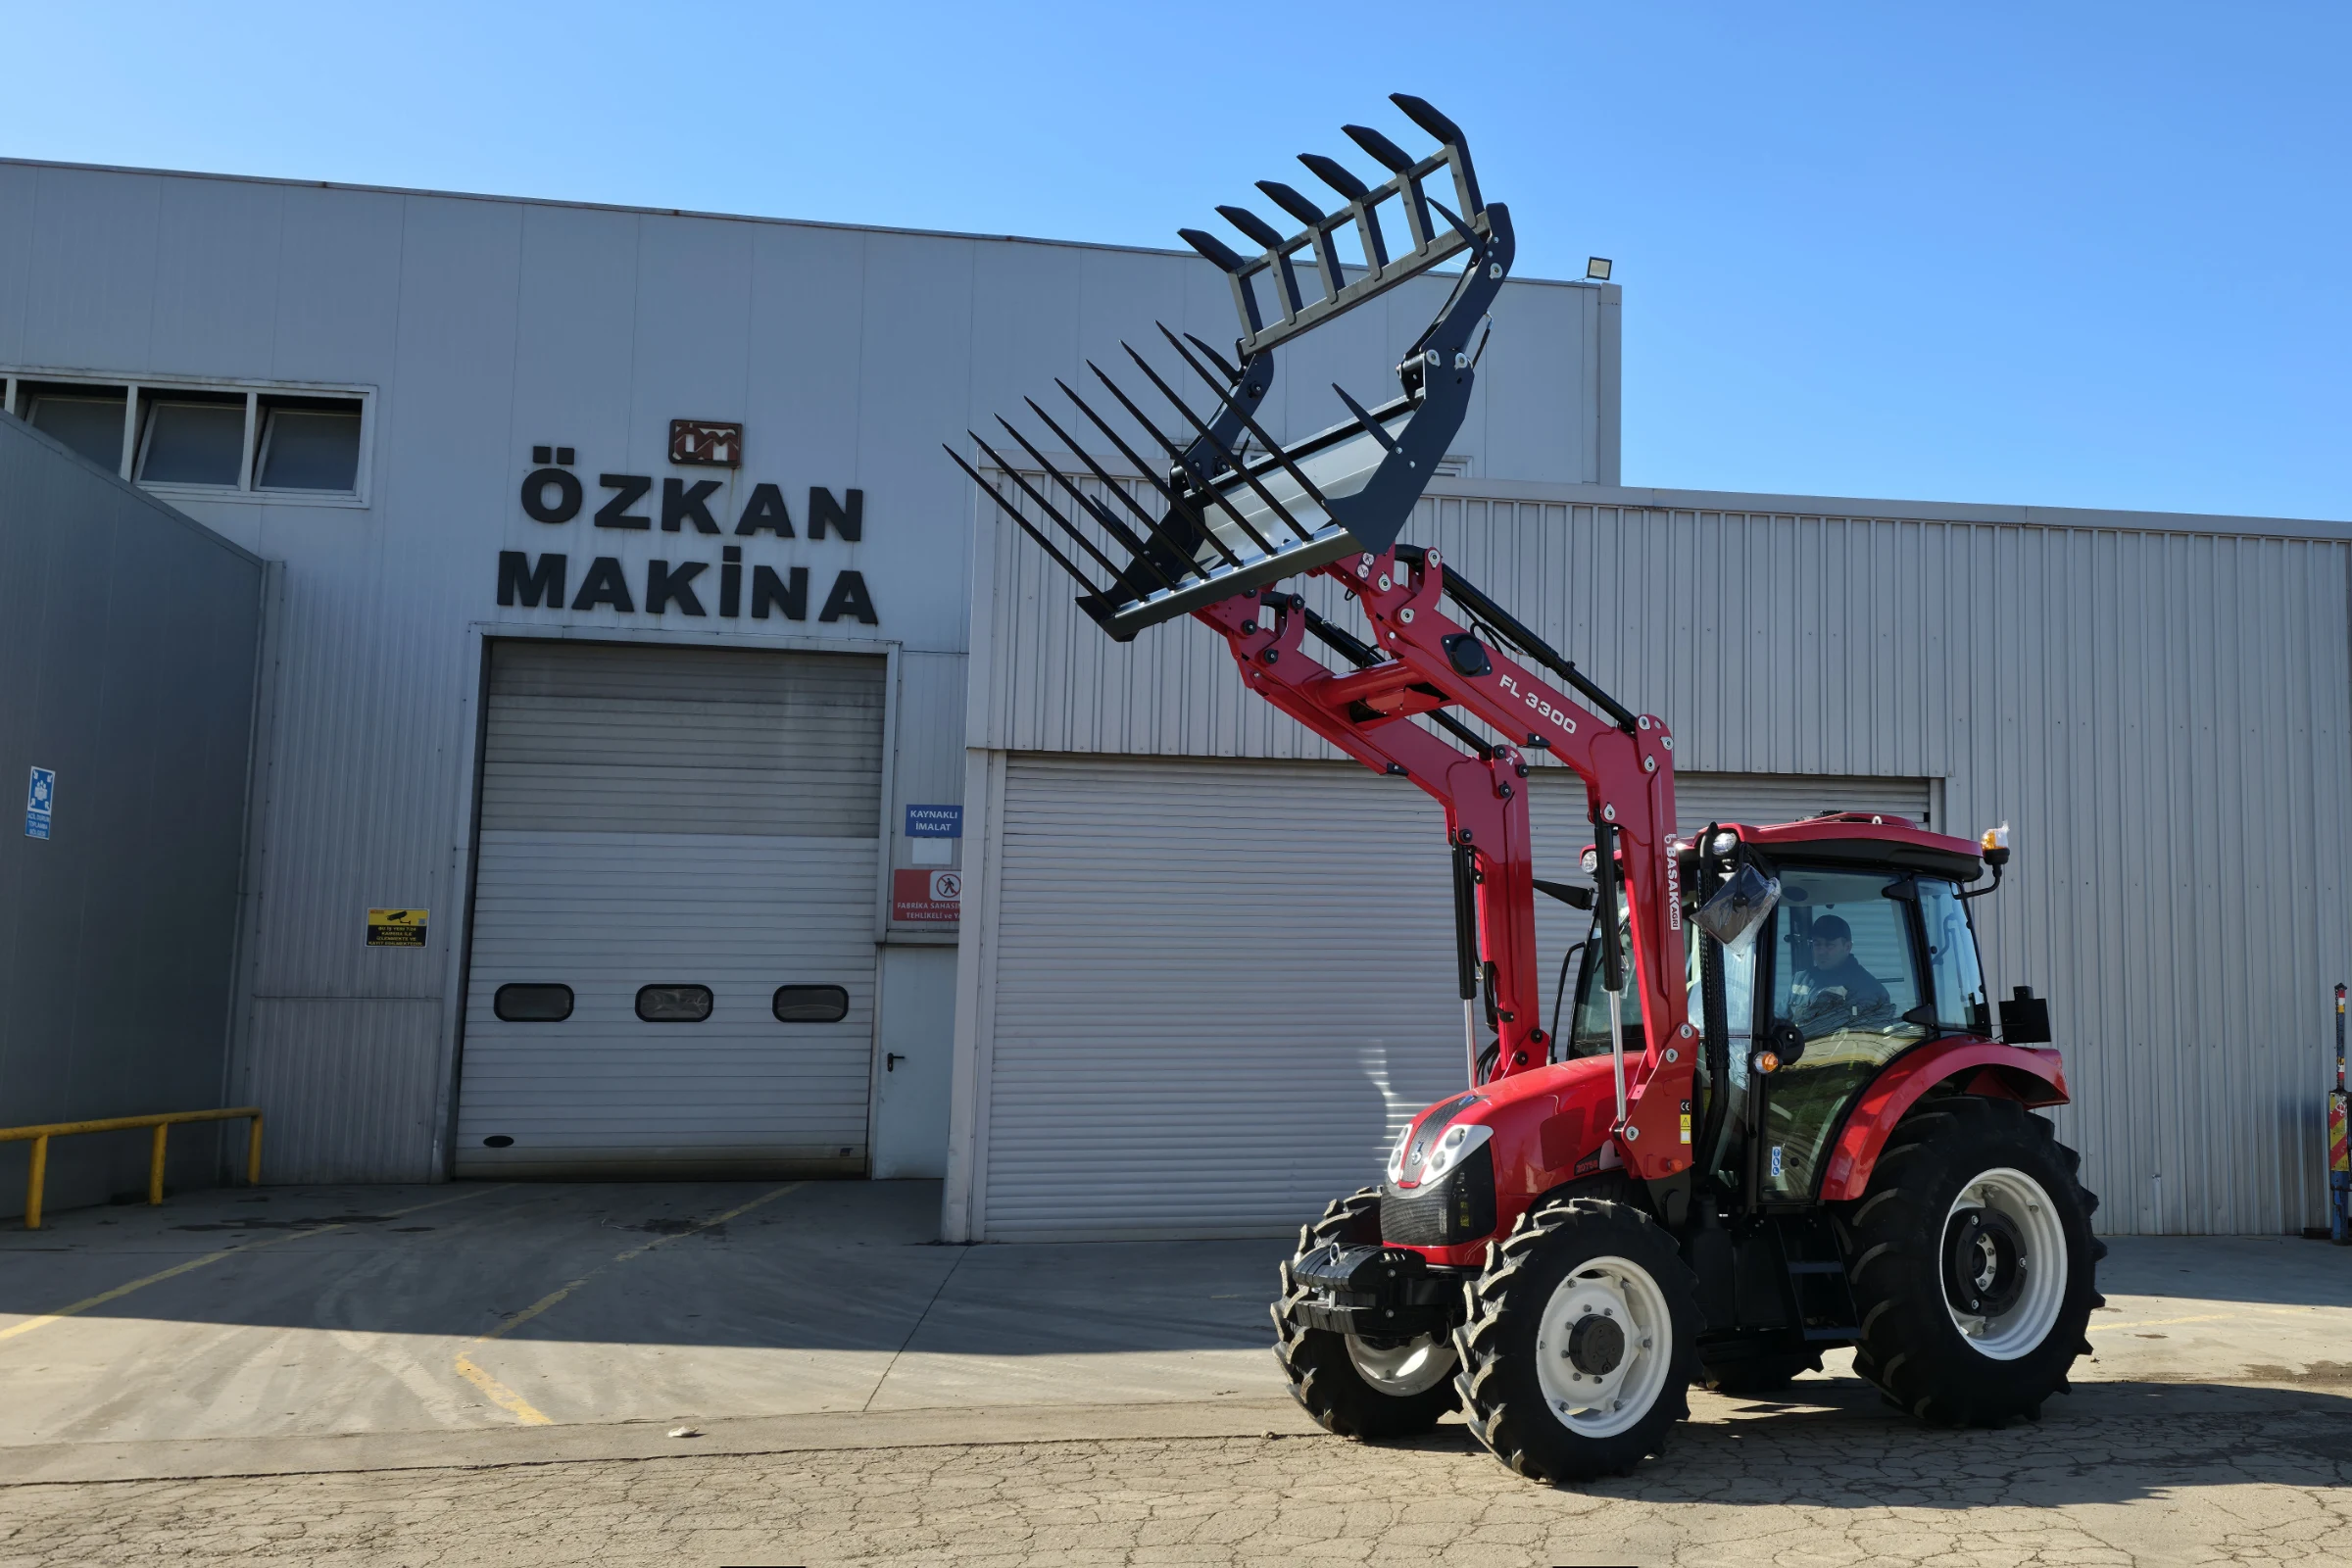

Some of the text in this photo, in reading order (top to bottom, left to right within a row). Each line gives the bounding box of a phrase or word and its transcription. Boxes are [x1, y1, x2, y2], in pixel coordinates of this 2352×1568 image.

[520, 445, 863, 542] ÖZKAN
[497, 545, 879, 625] MAKİNA
[1498, 673, 1577, 734] FL 3300
[909, 809, 958, 819] KAYNAKLI
[915, 820, 952, 831] İMALAT
[1680, 1102, 1690, 1111] CE
